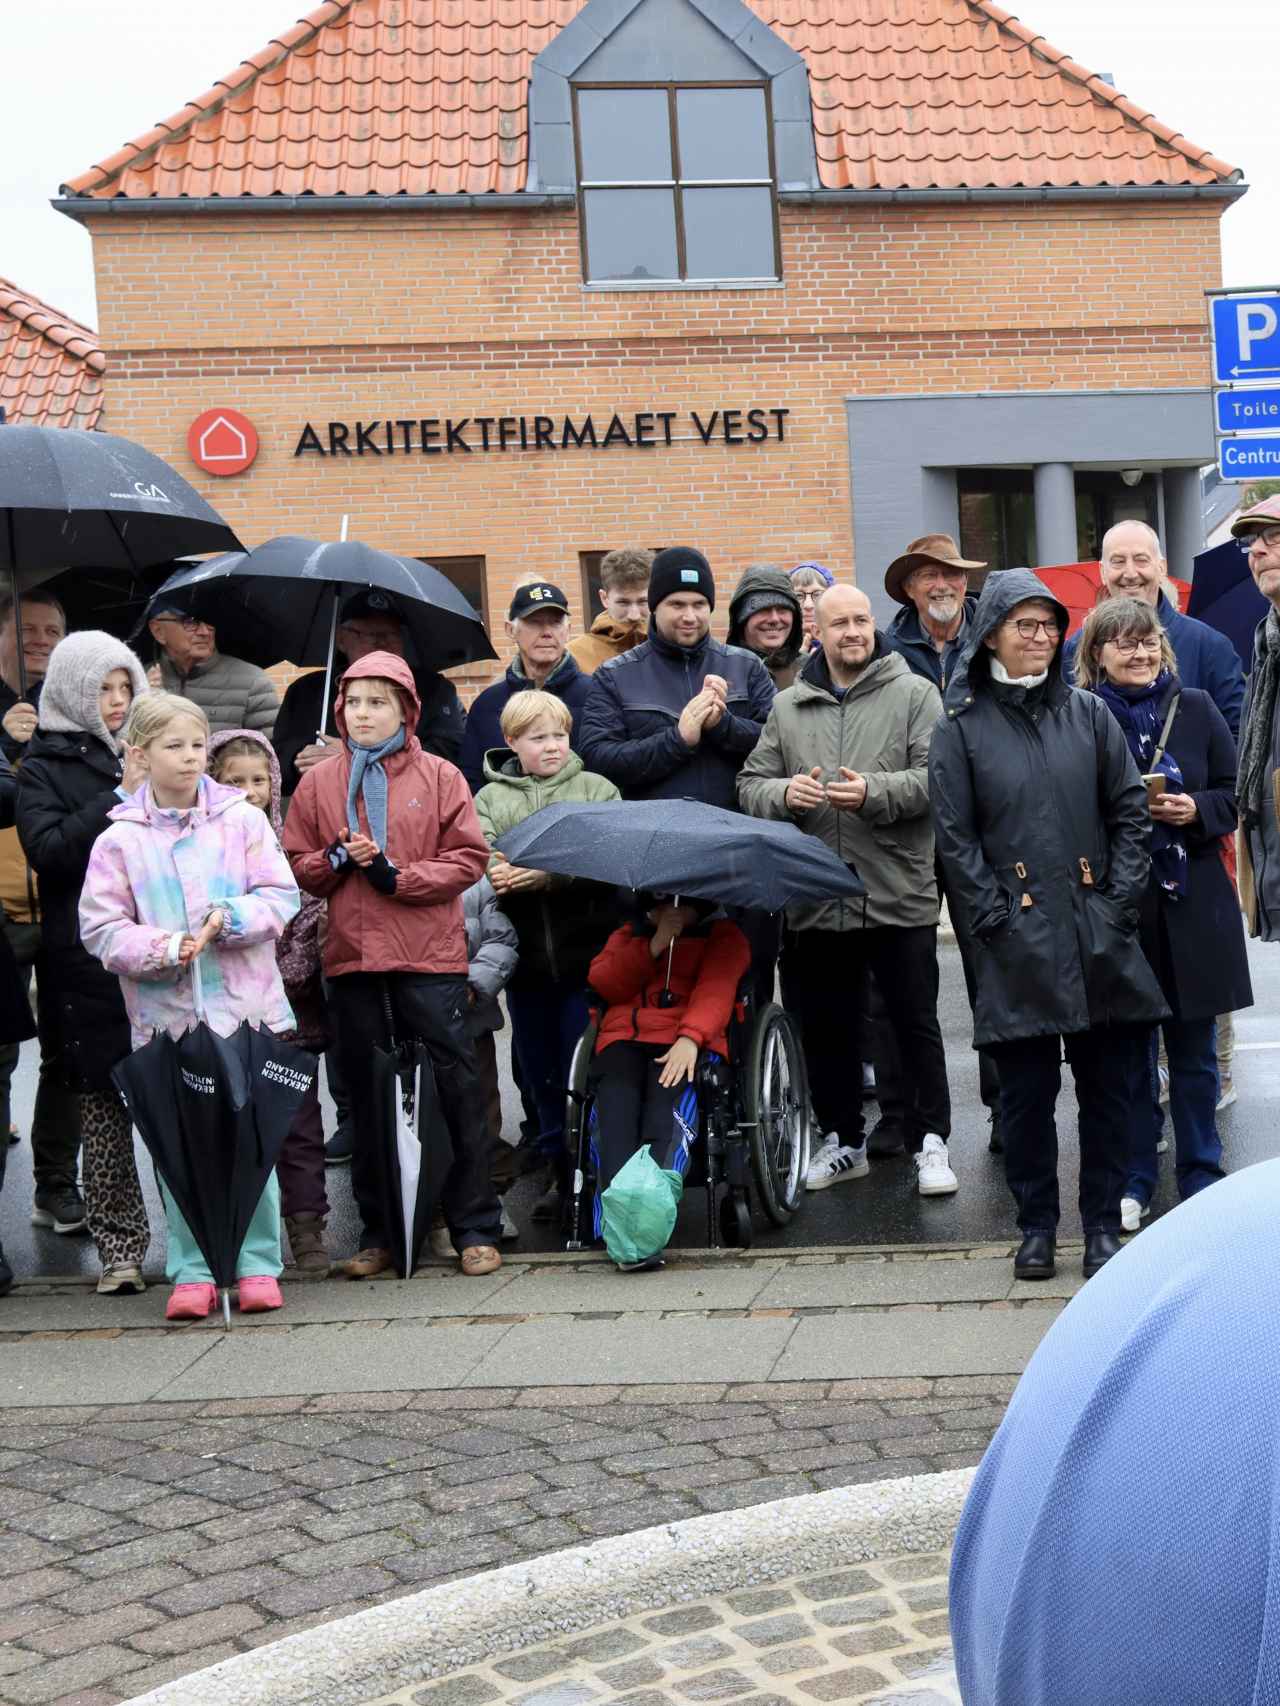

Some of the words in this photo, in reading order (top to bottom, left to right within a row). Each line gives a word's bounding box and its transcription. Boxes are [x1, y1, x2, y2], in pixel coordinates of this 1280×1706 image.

[1236, 303, 1277, 361] P
[294, 412, 677, 457] ARKITEKTFIRMAET
[691, 408, 790, 446] VEST
[260, 1067, 310, 1092] REKASSEN
